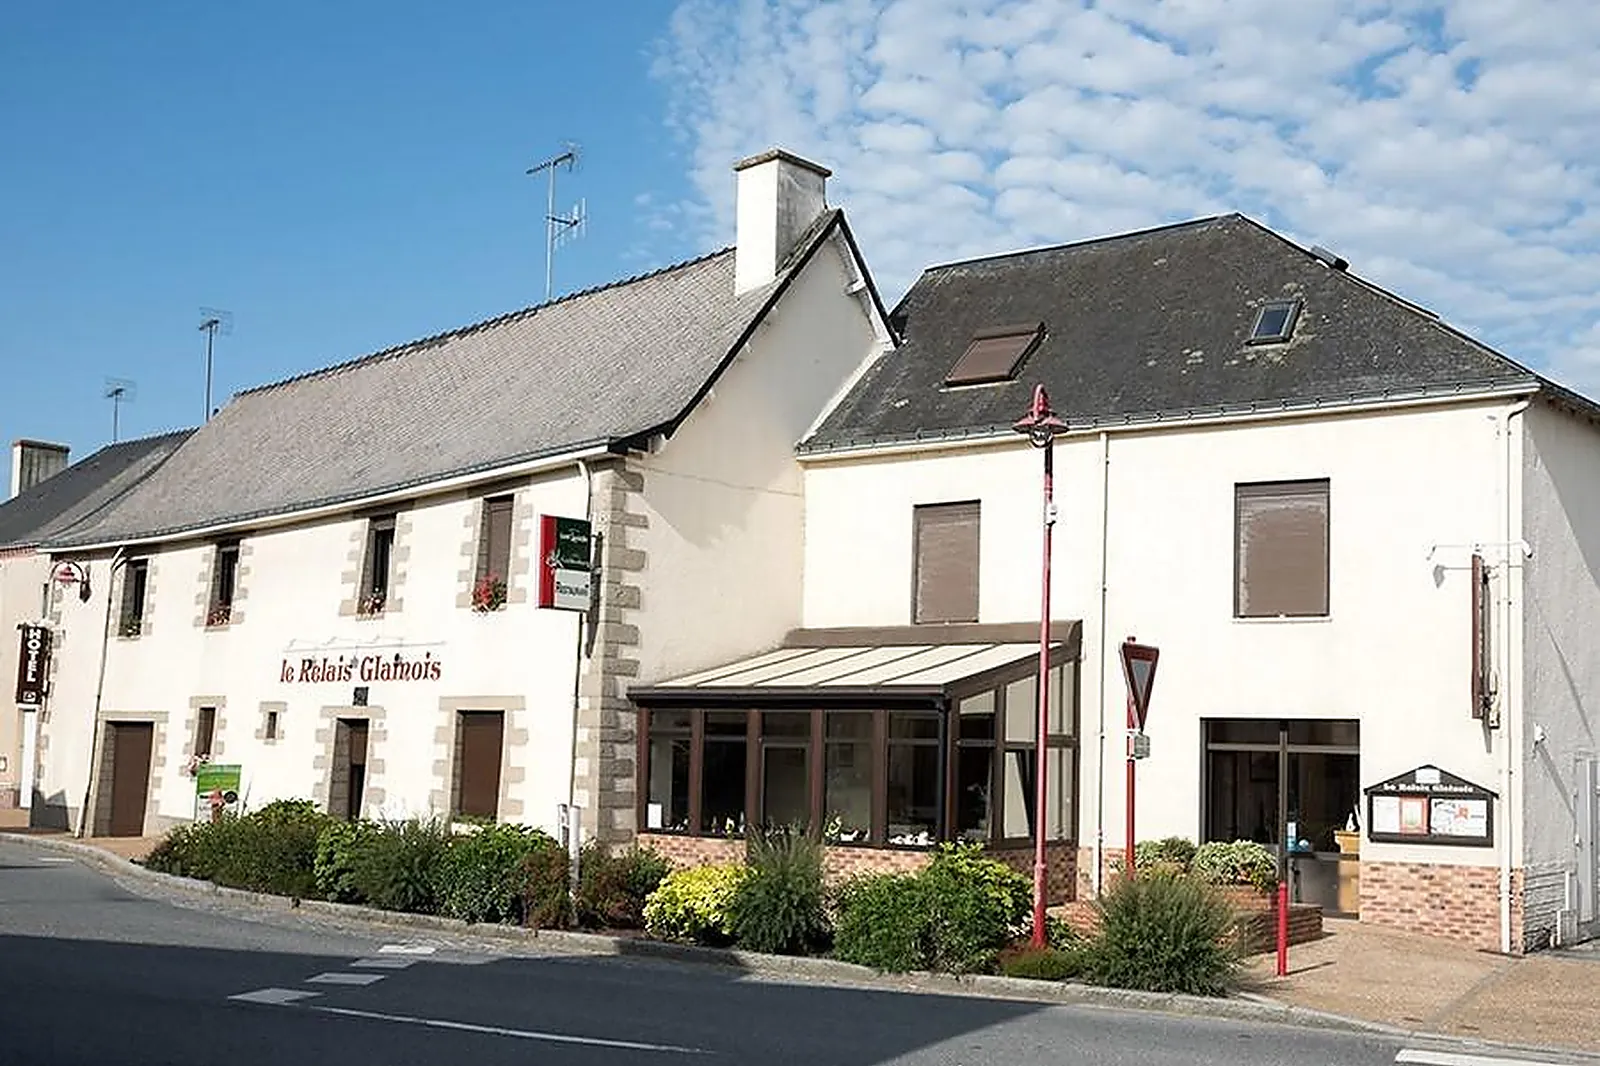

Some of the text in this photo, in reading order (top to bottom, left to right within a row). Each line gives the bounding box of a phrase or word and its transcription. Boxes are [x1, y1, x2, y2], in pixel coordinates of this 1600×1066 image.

[26, 628, 42, 682] HOTEL
[280, 659, 294, 683] le
[298, 656, 353, 683] Relais
